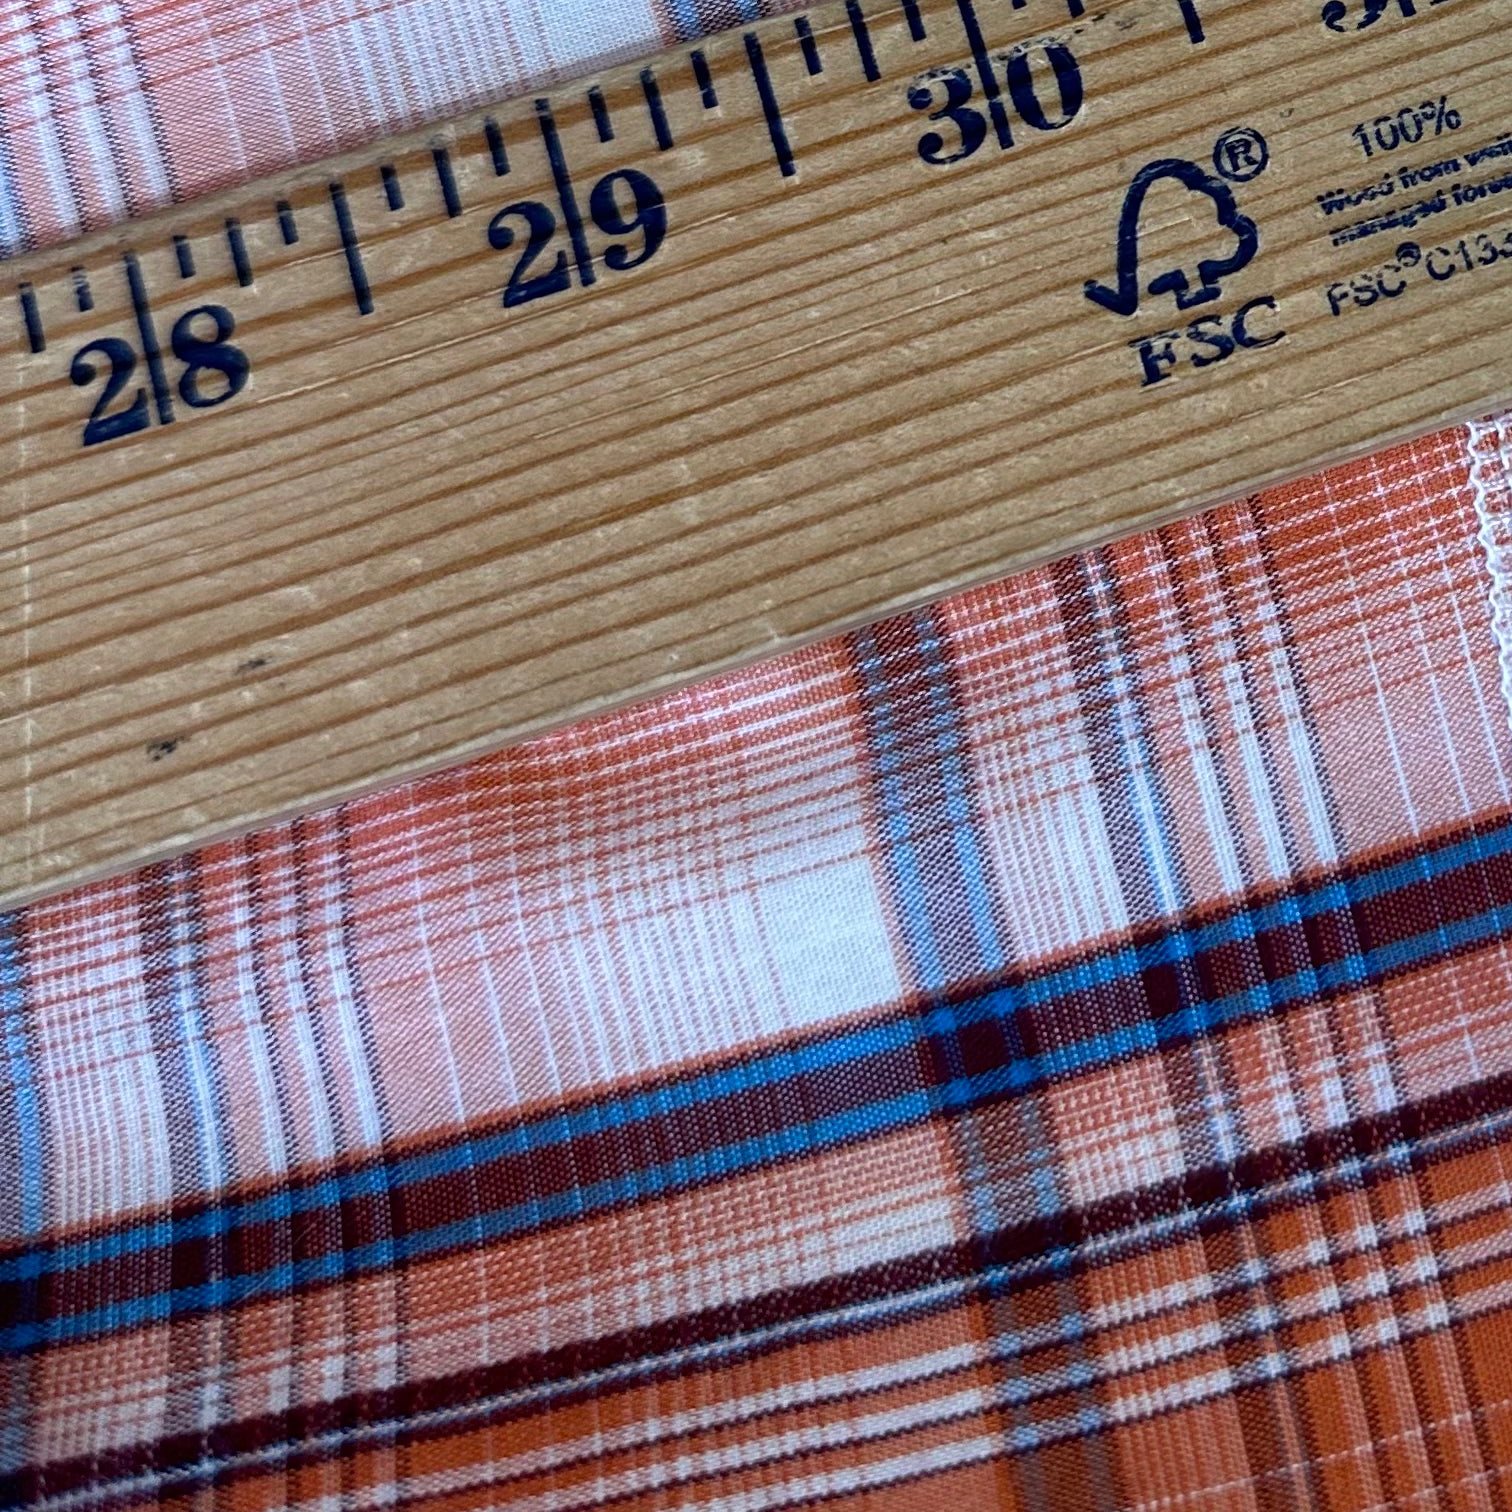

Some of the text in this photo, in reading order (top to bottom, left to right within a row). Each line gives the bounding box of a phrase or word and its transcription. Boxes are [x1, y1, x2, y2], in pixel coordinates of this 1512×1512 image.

[1352, 95, 1462, 157] 100%
[70, 304, 250, 446] 28
[488, 169, 667, 308] 29
[907, 40, 1084, 165] 30
[1128, 295, 1287, 387] FSC
